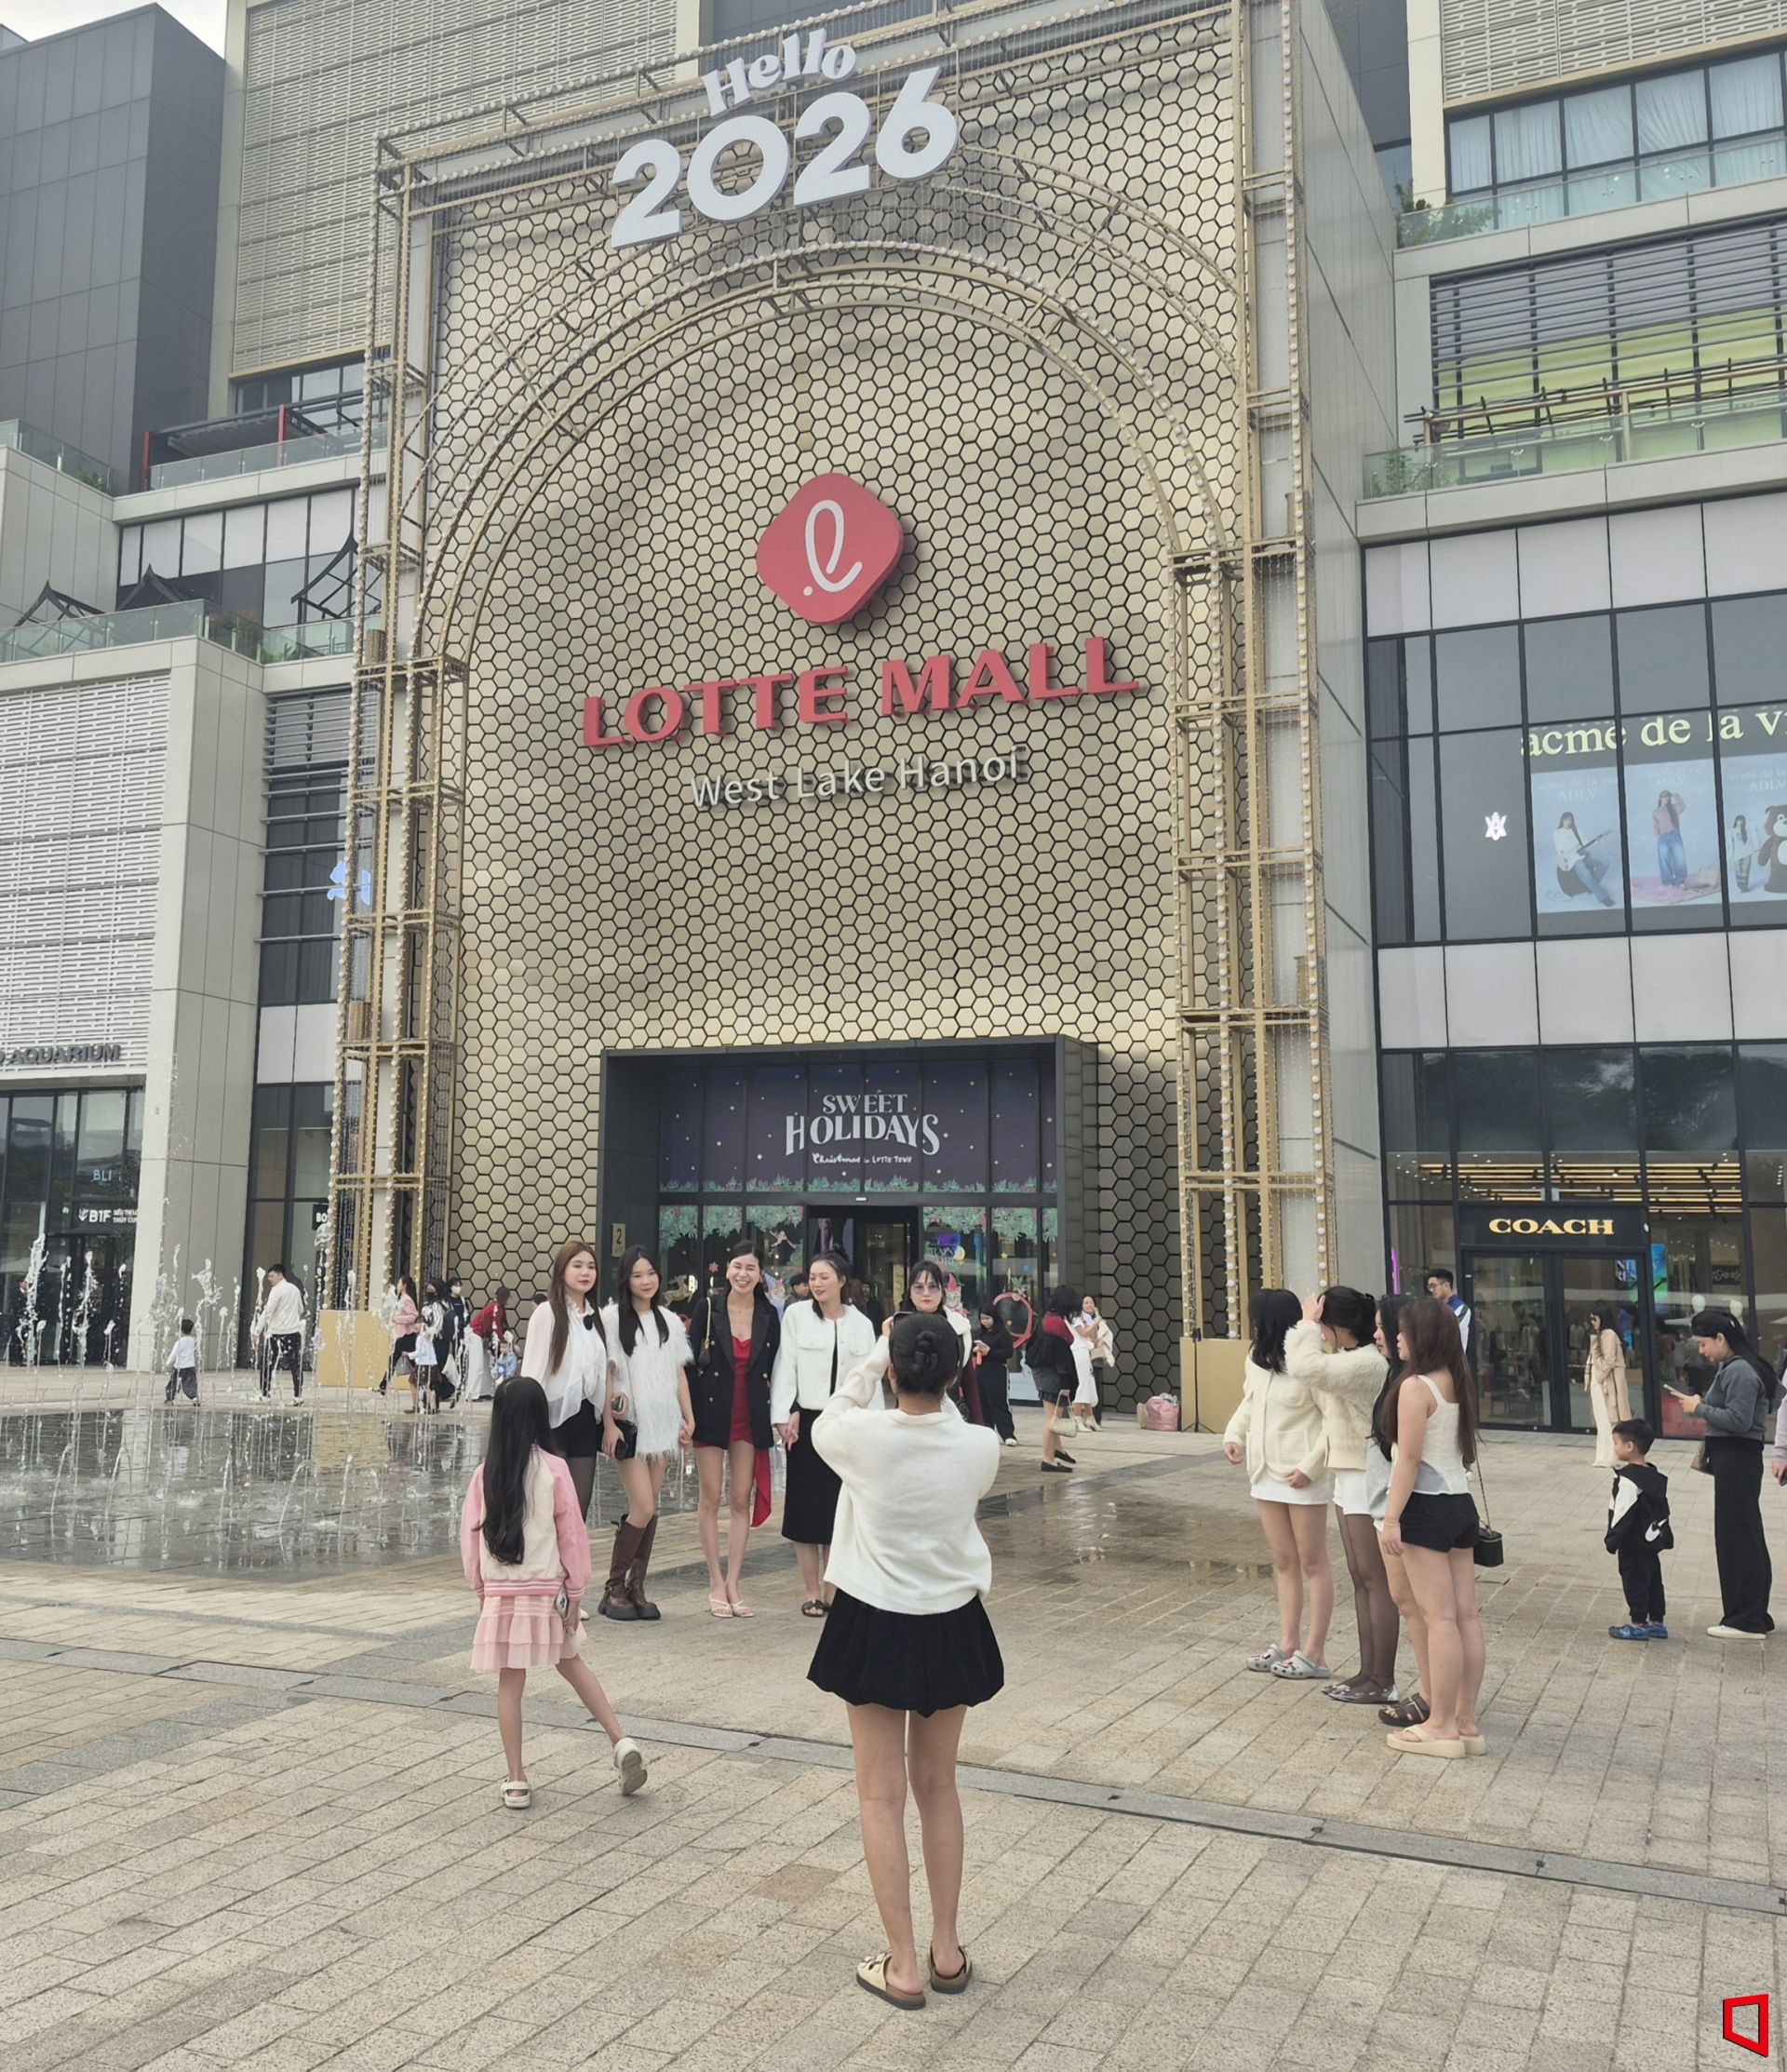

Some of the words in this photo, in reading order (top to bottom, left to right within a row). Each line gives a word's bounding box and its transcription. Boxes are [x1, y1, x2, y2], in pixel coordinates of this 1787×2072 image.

[702, 28, 857, 117] Hello
[611, 66, 959, 250] 2026
[583, 665, 851, 748] LOTTE
[880, 636, 1141, 717] MALL
[1640, 715, 1691, 747] de
[691, 773, 781, 808] West
[796, 759, 886, 800] Lake
[898, 745, 1025, 790] Hanoi
[6, 1044, 122, 1066] AQUARIUM
[822, 1093, 908, 1114] SWEET
[786, 1113, 941, 1156] HOLIDAYS
[616, 1228, 622, 1245] 2
[1489, 1218, 1614, 1235] COACH
